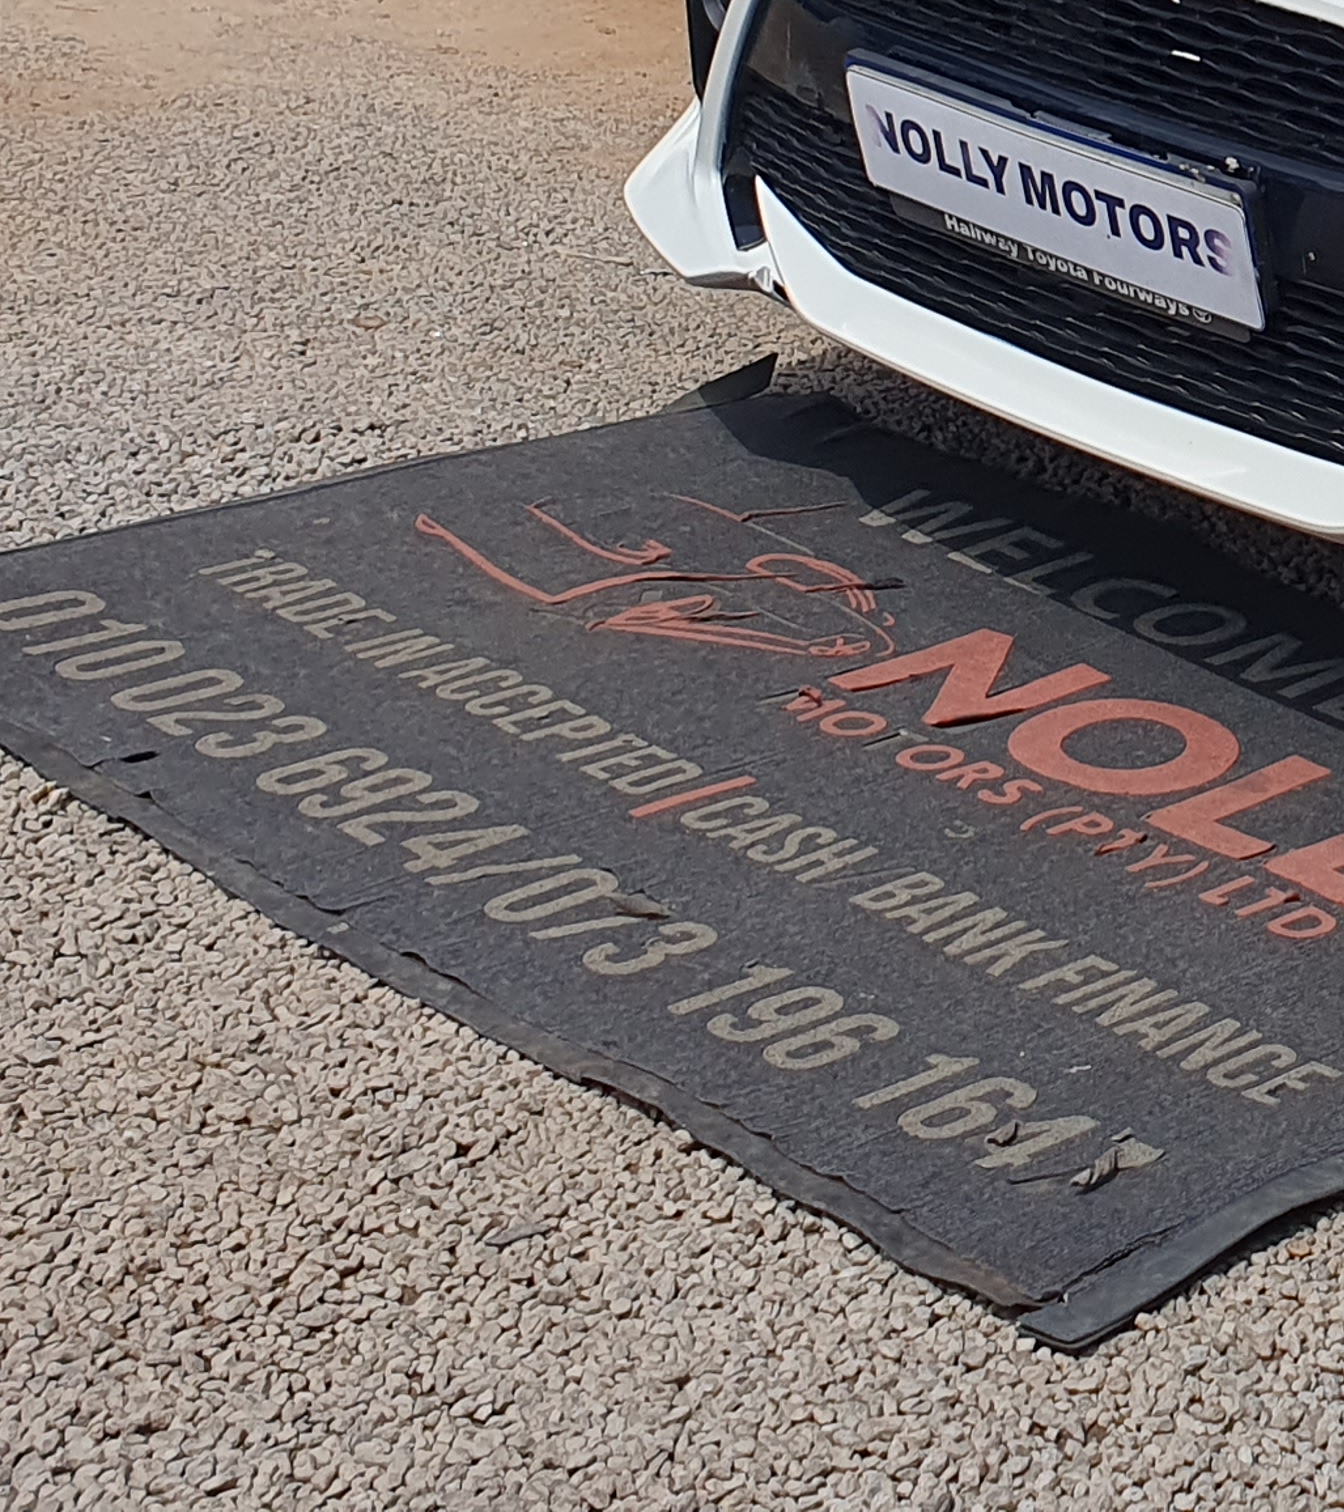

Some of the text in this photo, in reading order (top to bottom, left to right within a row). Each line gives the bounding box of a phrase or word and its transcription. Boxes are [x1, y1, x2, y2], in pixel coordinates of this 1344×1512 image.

[865, 103, 1233, 276] NOLLY MOTORS
[1024, 244, 1090, 282] Toyota
[1092, 269, 1191, 318] Fourways
[0, 589, 187, 681] 010
[110, 668, 328, 758] 023
[668, 964, 902, 1071] 196
[198, 548, 398, 640] TRADE
[344, 628, 455, 668] IN
[1018, 954, 1343, 1107] FINANCE
[1199, 875, 1338, 940] LTD
